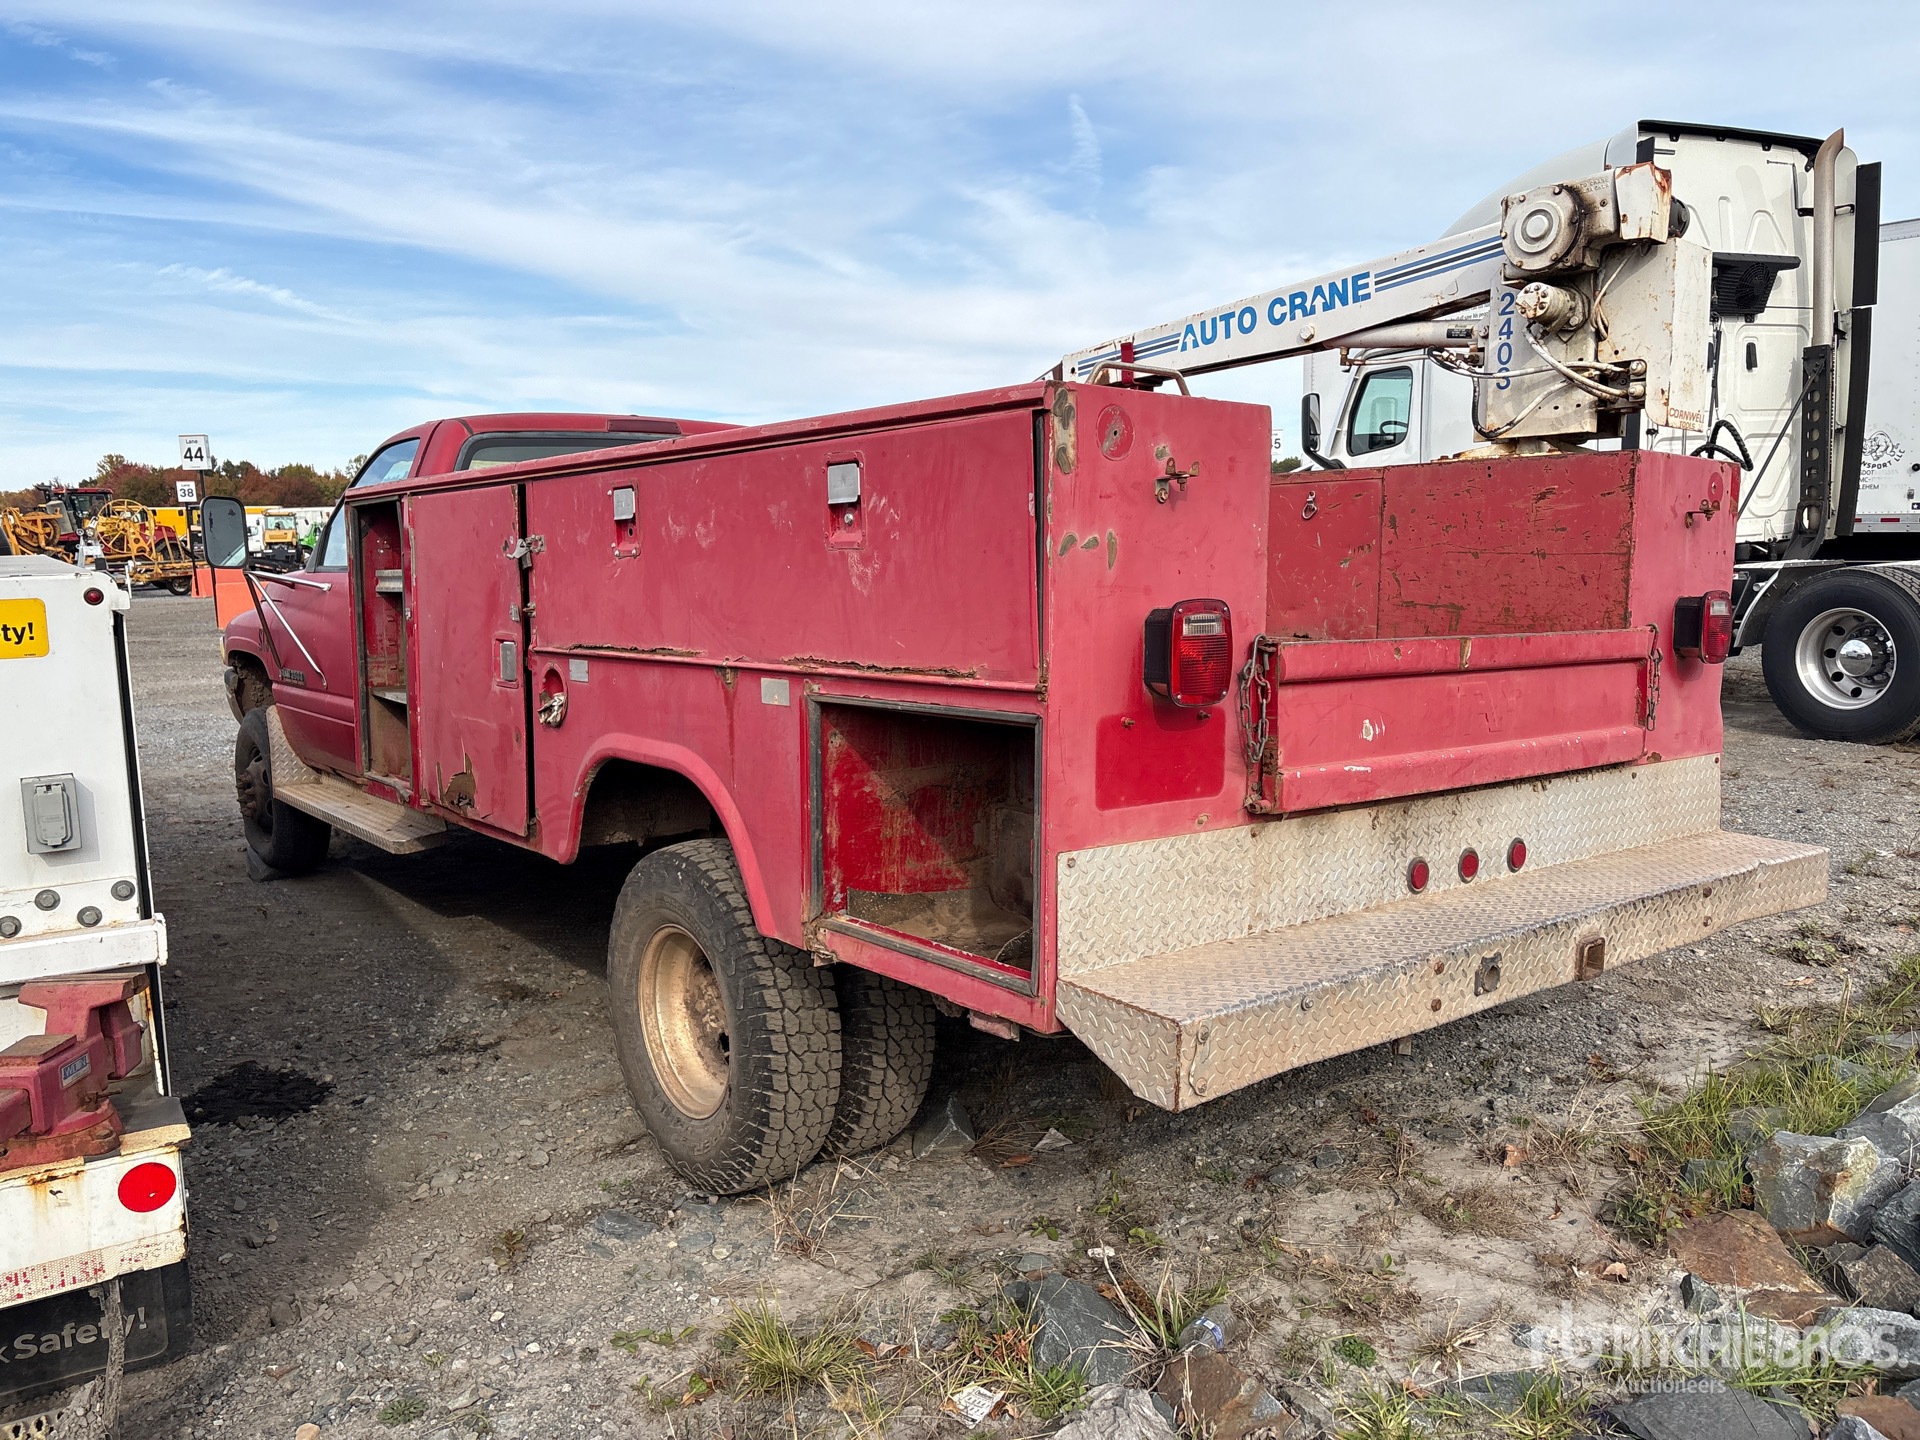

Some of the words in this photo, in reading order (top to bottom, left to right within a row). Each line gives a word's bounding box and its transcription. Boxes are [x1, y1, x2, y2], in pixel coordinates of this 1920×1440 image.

[1180, 306, 1257, 352] AUTO
[1267, 271, 1371, 326] CRANE
[1495, 292, 1516, 390] 2403
[1669, 407, 1705, 424] CORNWELL
[1680, 420, 1696, 430] TOOLS
[183, 446, 204, 462] 44
[1860, 459, 1892, 470] NSPORT
[1893, 448, 1906, 462] LLC
[179, 488, 194, 498] 38
[0, 622, 35, 645] ty!
